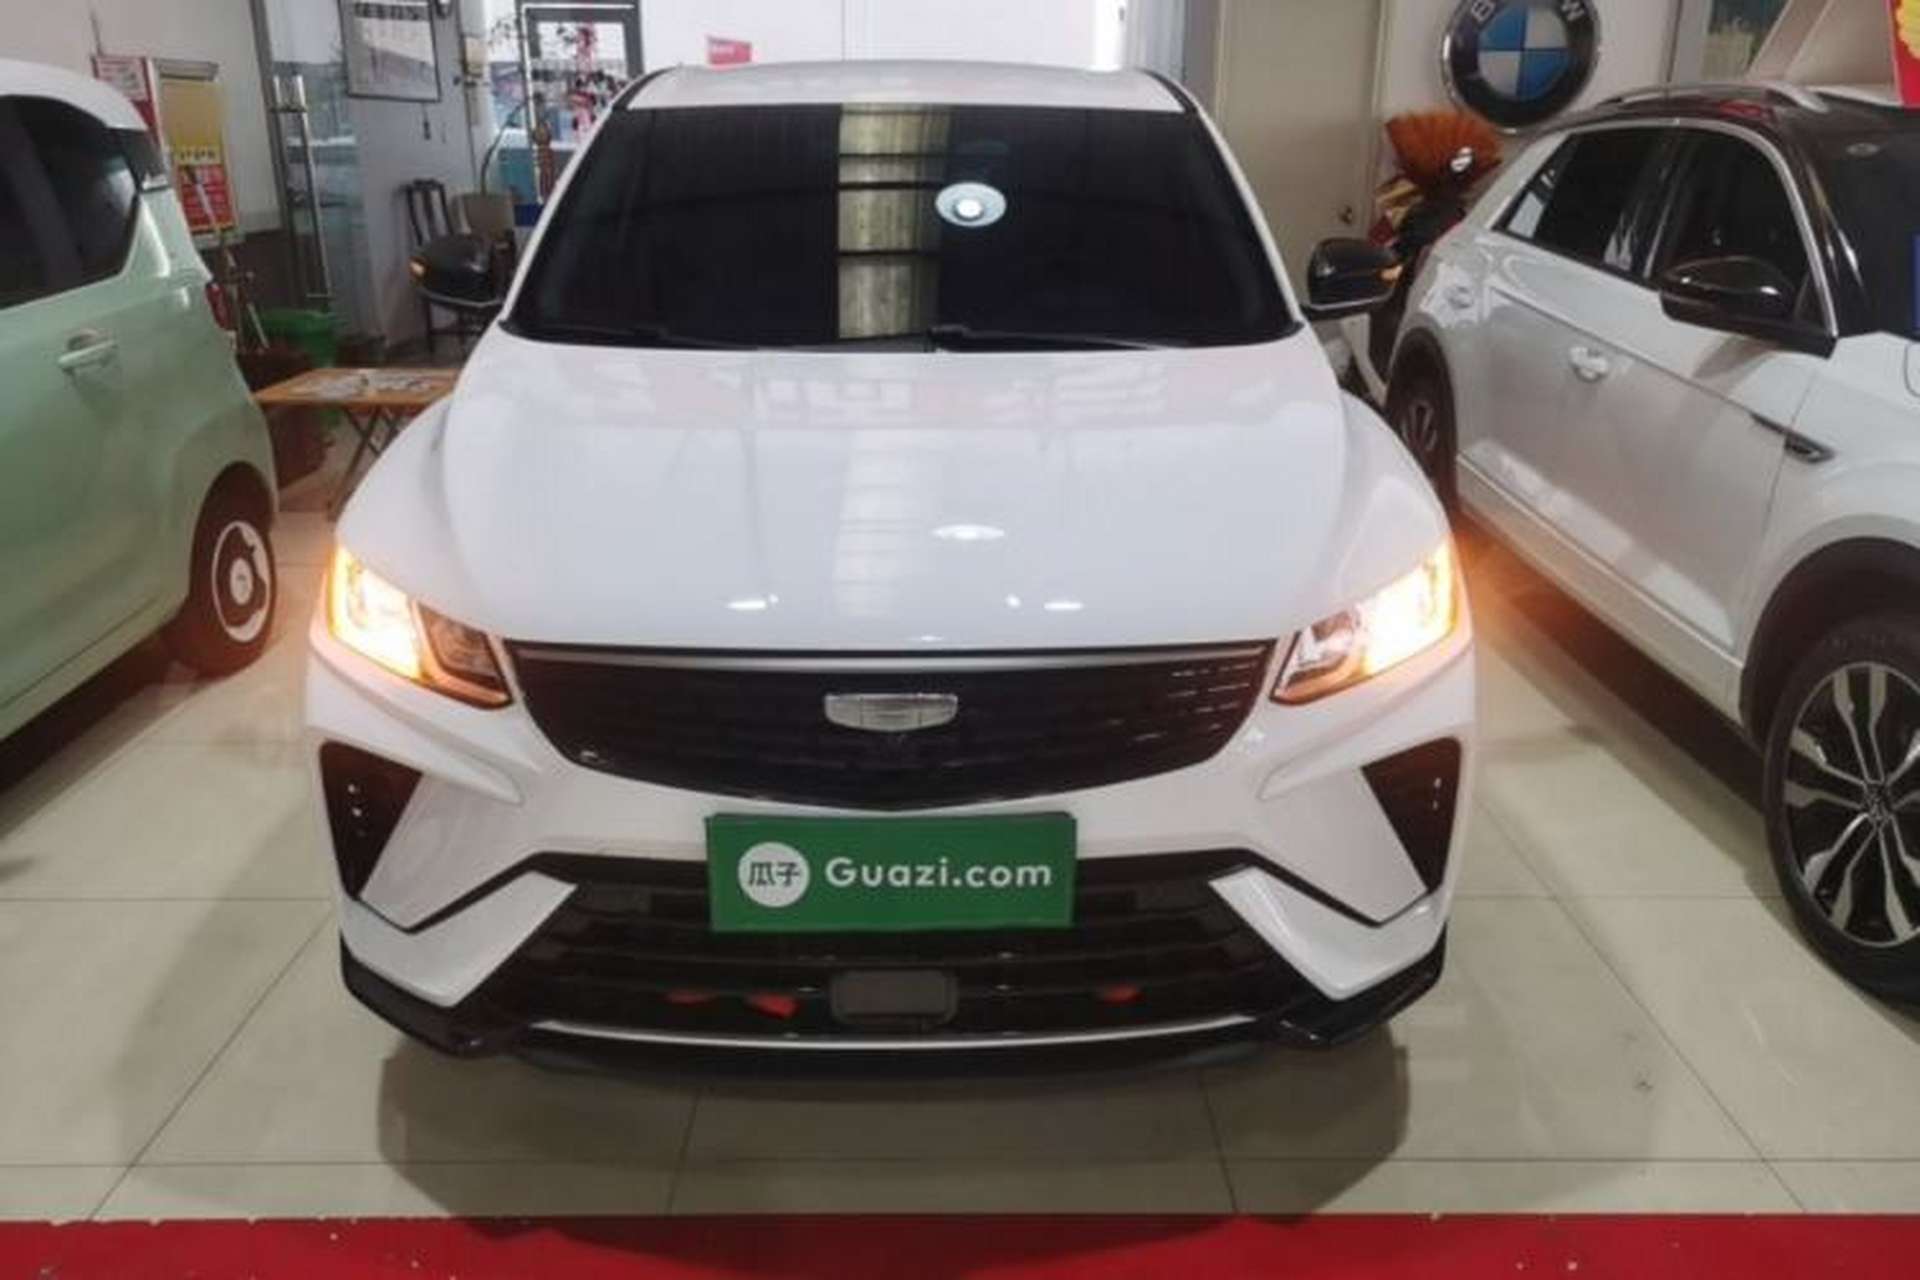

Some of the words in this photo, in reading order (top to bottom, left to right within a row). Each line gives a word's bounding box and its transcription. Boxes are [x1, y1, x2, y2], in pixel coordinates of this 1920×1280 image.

[1472, 0, 1584, 21] BW
[749, 861, 800, 887] 瓜子
[825, 857, 1052, 887] Guazi.com
